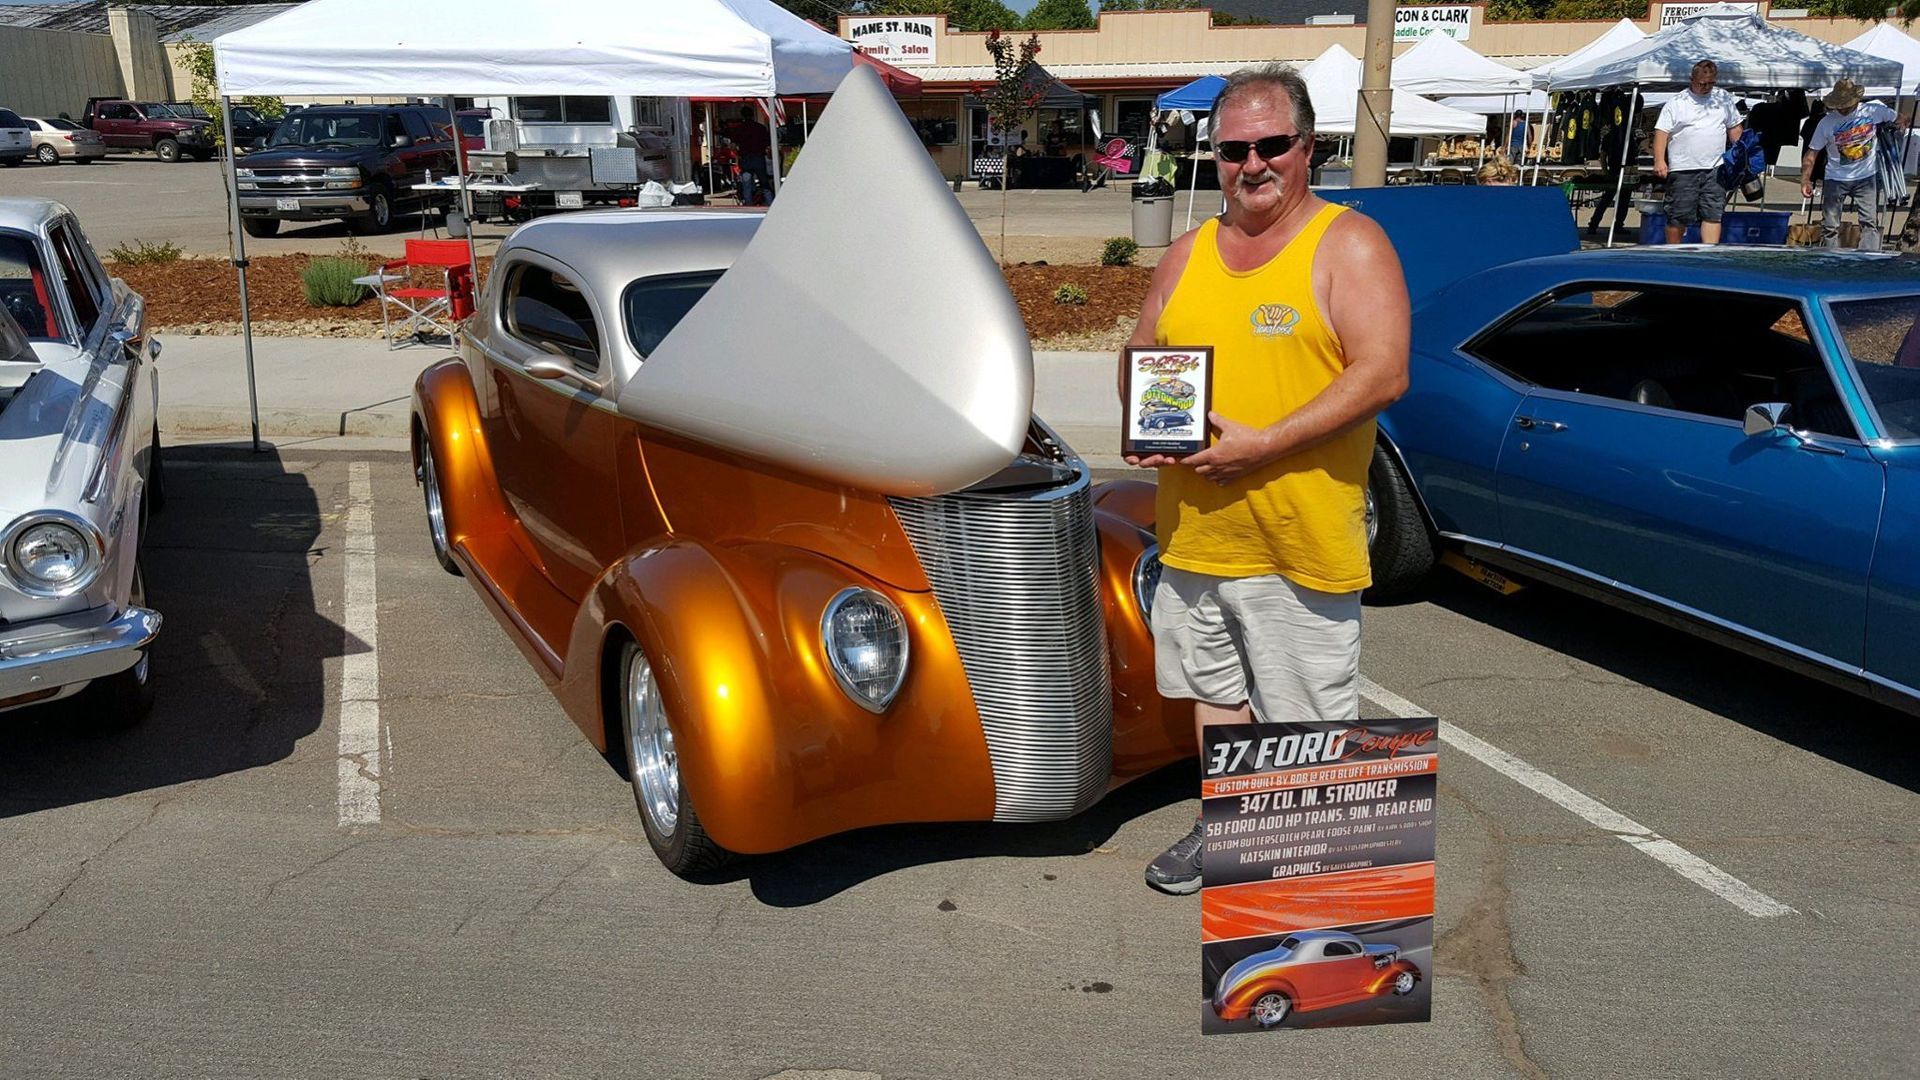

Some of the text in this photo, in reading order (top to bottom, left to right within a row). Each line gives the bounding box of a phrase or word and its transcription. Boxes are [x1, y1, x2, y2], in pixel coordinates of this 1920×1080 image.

[1421, 10, 1430, 21] &
[1432, 9, 1469, 24] CLARK
[1665, 6, 1708, 16] FERGUS
[852, 21, 933, 38] MANE ST. HAIR
[1394, 27, 1418, 37] addle
[857, 44, 929, 55] Family Salon
[1207, 727, 1433, 775] 37 FORD Coupe
[1215, 781, 1249, 793] CUSTOM
[1250, 777, 1274, 789] BUILT
[1276, 775, 1289, 786] BY
[1290, 773, 1308, 785] BOB
[1319, 769, 1336, 781] RED
[1338, 767, 1365, 779] BLUFF
[1366, 760, 1429, 776] TRANSMISSION
[1240, 779, 1398, 814] 347 CU. IN. STROKER
[1207, 798, 1432, 837] SB FORD AOD HP TRANS. 9IN. REAR END
[1207, 839, 1240, 852] CUSTOM
[1240, 832, 1300, 848] BUTTERSCOTCH
[1301, 827, 1326, 840] PEARL
[1326, 826, 1353, 838] FOOSE
[1353, 823, 1376, 834] PAINT
[1240, 848, 1281, 864] KATSKIN
[1282, 843, 1328, 859] INTERIOR
[1273, 861, 1321, 877] GRAPHICS
[1346, 860, 1373, 869] GRAPHICS
